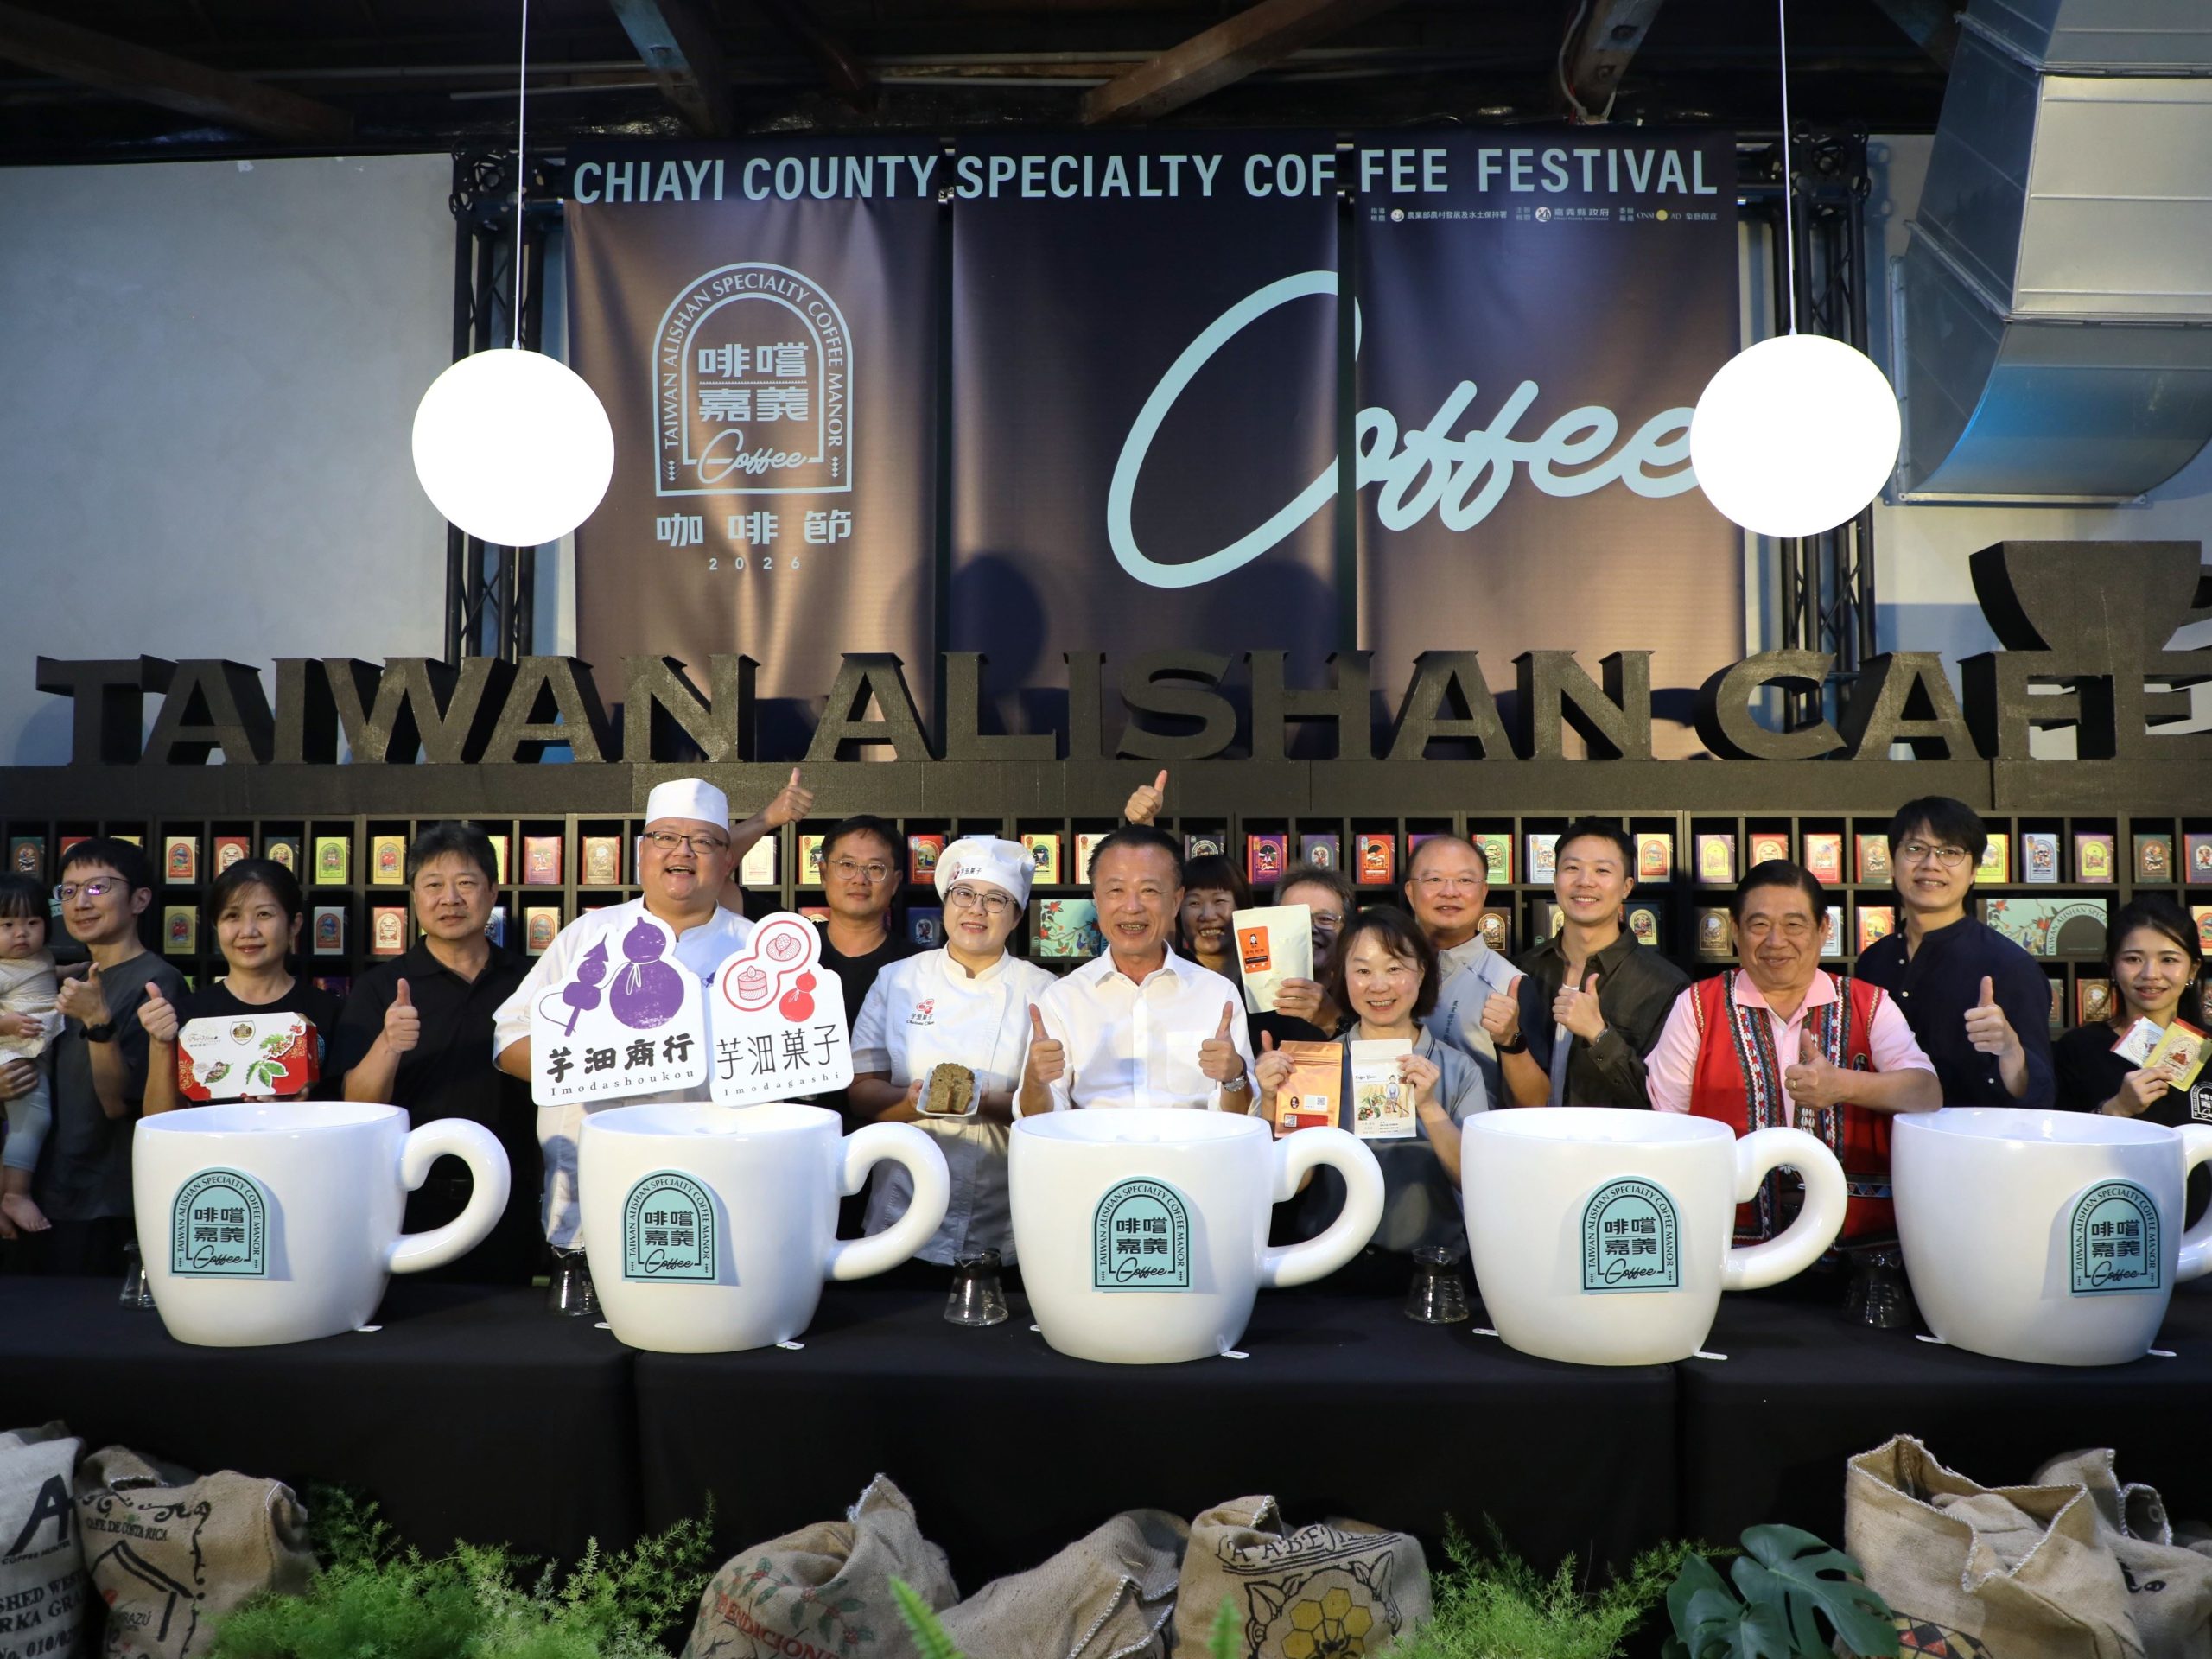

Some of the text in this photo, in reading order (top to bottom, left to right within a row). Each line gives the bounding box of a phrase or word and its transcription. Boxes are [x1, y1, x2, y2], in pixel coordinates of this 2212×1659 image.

[573, 159, 725, 204] CHIAYI
[743, 155, 938, 200] COUNTY
[956, 154, 1223, 199] SPECIALTY
[1478, 148, 1718, 194] FESTIVAL
[664, 273, 843, 449] TAIWAN ALISHAN SPECIALTY COFFEE MANOR
[698, 386, 809, 422] 嘉義
[697, 428, 807, 484] Coffee
[656, 509, 852, 547] 咖啡節
[709, 556, 800, 570] 2026
[36, 654, 760, 765] TAIWAN
[800, 652, 1657, 762] ALISHAN
[551, 1070, 694, 1096] Imodashoukou
[724, 1071, 840, 1096] Imodagashi
[178, 1182, 201, 1217] ALISHAN
[202, 1176, 246, 1190] SPECIALTY
[245, 1189, 261, 1220] COFFEE
[629, 1185, 650, 1221] ALISHAN
[651, 1178, 694, 1192] SPECIALTY
[693, 1192, 709, 1223] COFFEE
[194, 1227, 245, 1243] 嘉義
[645, 1230, 694, 1246] 嘉義
[1100, 1192, 1122, 1228] ALISHAN
[1122, 1185, 1168, 1199] SPECIALTY
[1167, 1198, 1185, 1230] COFFEE
[1176, 1231, 1185, 1267] MANOR
[1588, 1194, 1610, 1230] ALISHAN
[1610, 1185, 1656, 1199] SPECIALTY
[1655, 1198, 1673, 1230] COFFEE
[1665, 1230, 1674, 1267] MANOR
[2076, 1197, 2098, 1234] ALISHAN
[2098, 1188, 2142, 1202] SPECIALTY
[2139, 1199, 2156, 1230] COFFEE
[2148, 1233, 2157, 1268] MANOR
[193, 1244, 243, 1269] Coffee
[1116, 1238, 1167, 1254] 嘉義
[1605, 1238, 1657, 1255] 嘉義
[2091, 1240, 2140, 1258] 嘉義
[645, 1249, 694, 1274] Coffee
[1116, 1257, 1167, 1282] Coffee
[1605, 1258, 1656, 1285] Coffee
[2091, 1261, 2140, 1287] Coffee
